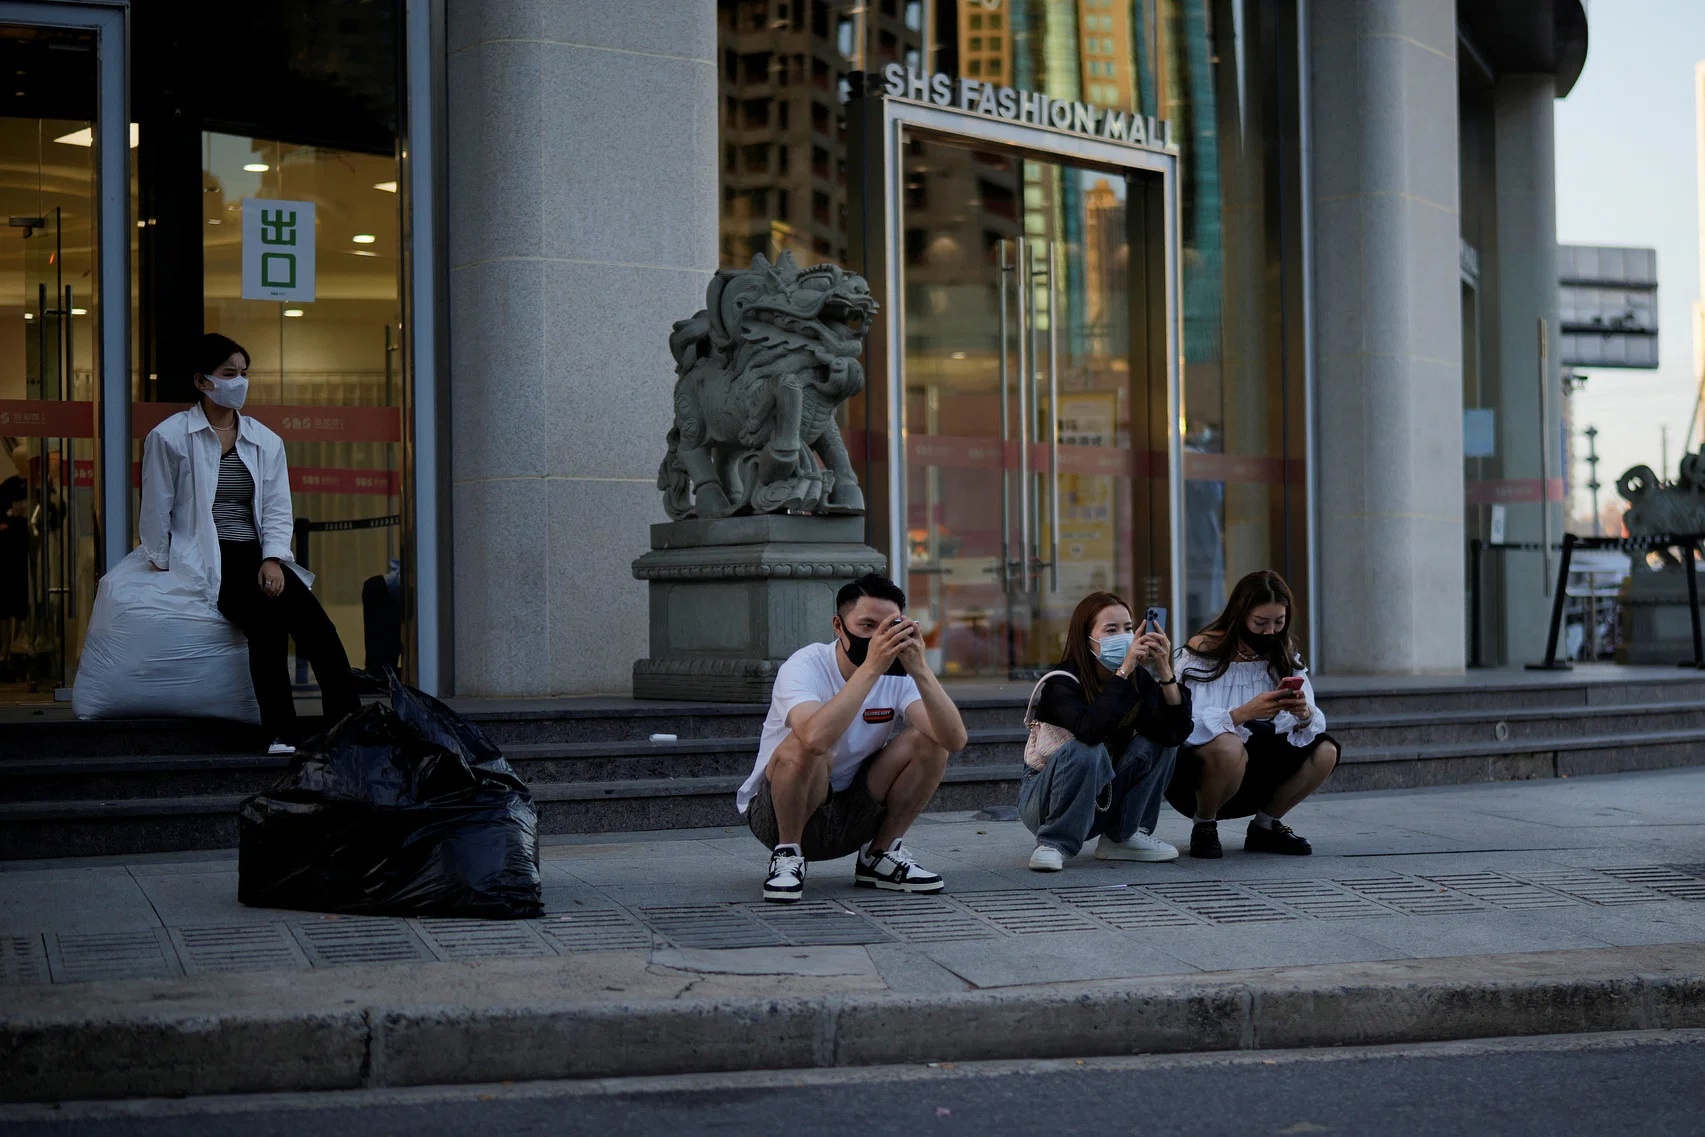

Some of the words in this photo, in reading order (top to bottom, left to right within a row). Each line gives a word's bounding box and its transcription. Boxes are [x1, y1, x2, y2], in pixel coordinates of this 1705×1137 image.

[884, 62, 951, 106] SHS
[960, 78, 1097, 135] FASHION
[1103, 108, 1179, 150] MALL
[261, 209, 296, 289] 出口
